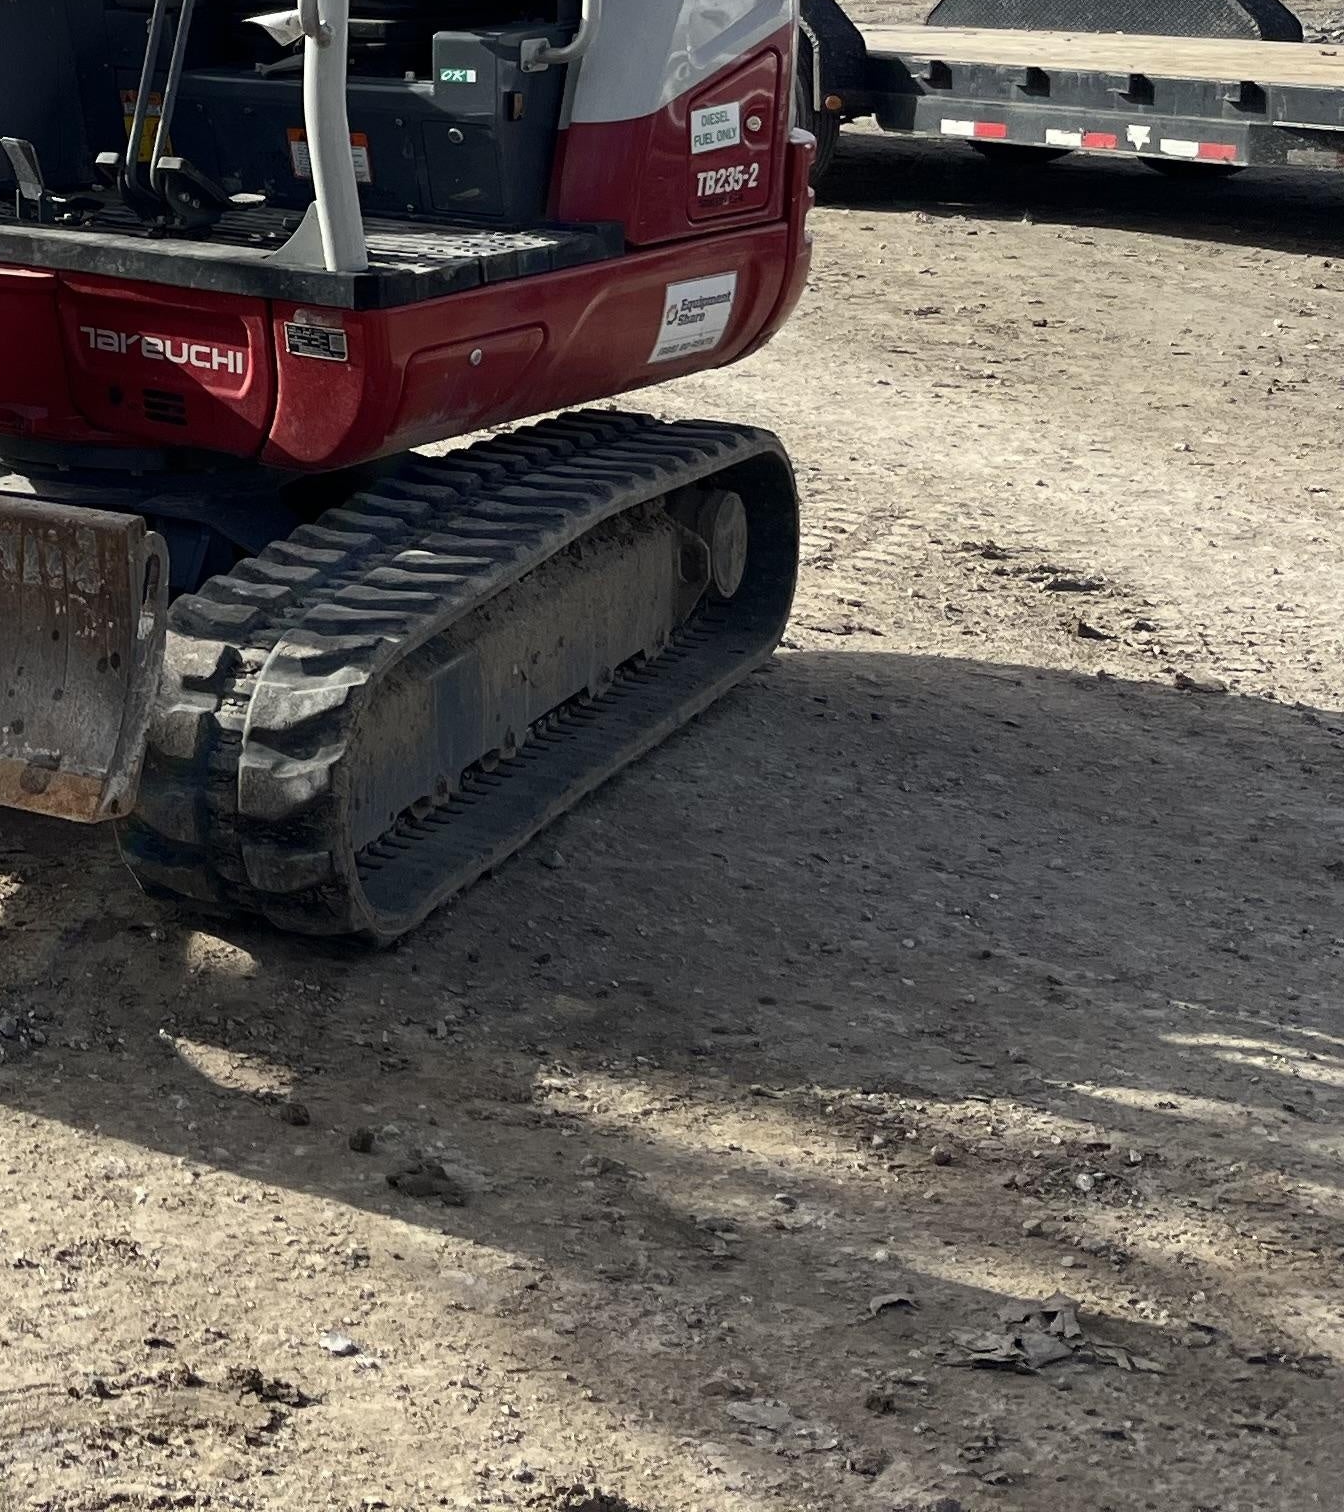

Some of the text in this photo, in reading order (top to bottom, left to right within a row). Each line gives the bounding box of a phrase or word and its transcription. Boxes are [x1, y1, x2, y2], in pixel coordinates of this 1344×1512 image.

[441, 70, 466, 81] OK
[701, 110, 730, 127] DIESEL
[694, 127, 738, 147] FUEL ONLY
[697, 162, 759, 197] TB235-2
[680, 291, 731, 312] Equipment
[677, 312, 706, 326] Share
